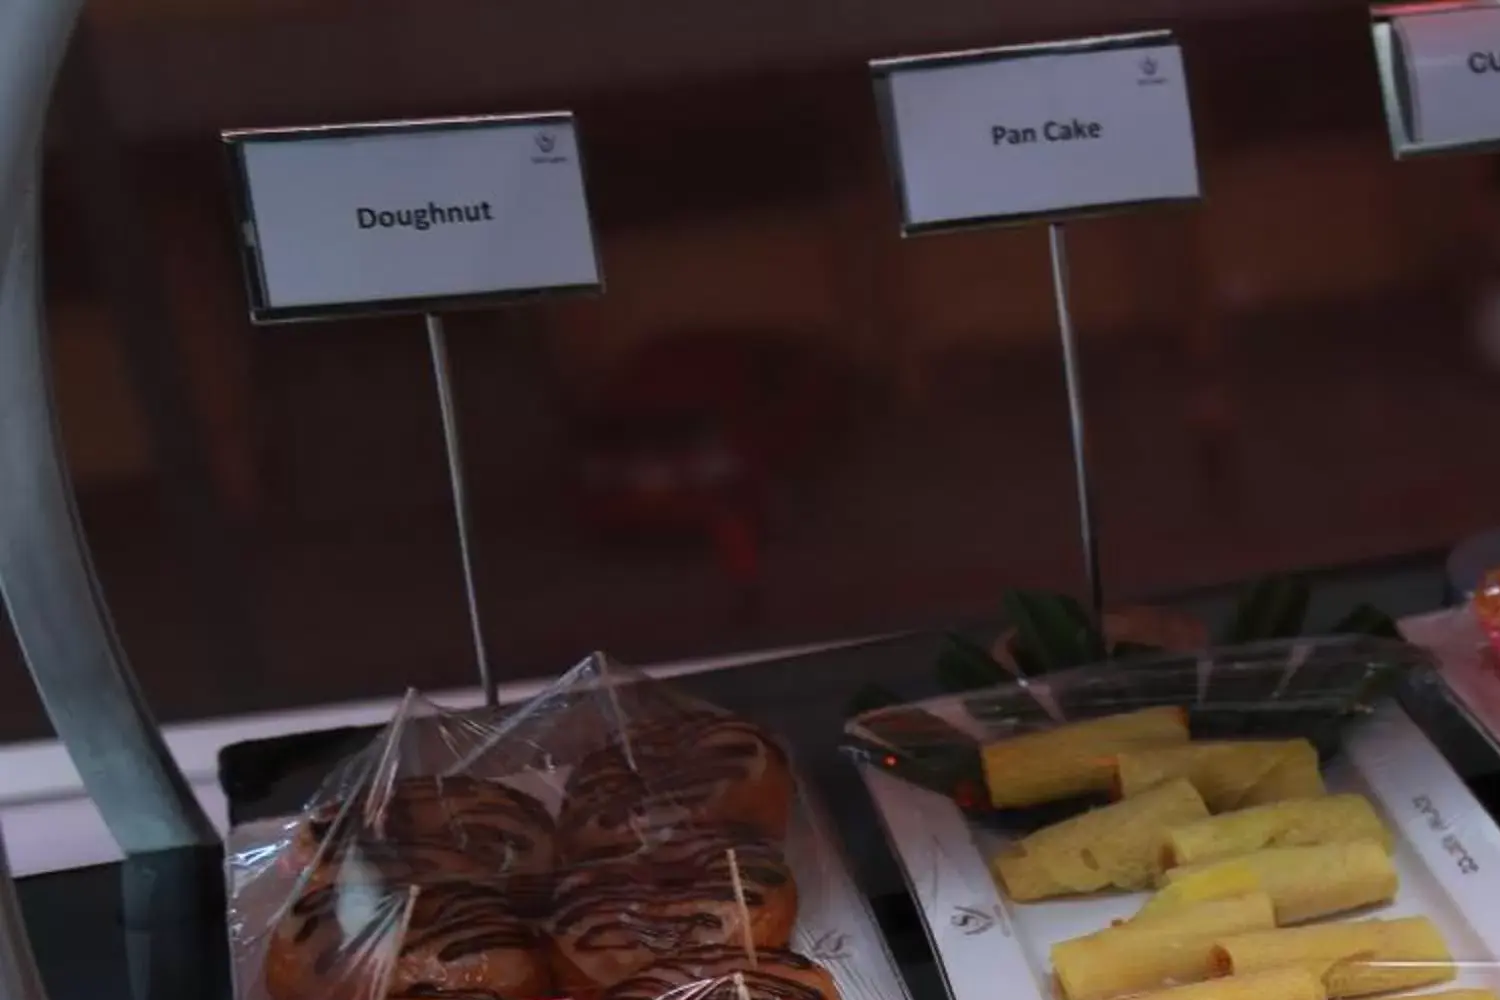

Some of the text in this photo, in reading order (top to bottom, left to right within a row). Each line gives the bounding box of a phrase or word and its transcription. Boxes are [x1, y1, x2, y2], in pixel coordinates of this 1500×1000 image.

[991, 119, 1102, 145] Pan Cake
[356, 202, 494, 230] Doughnut
